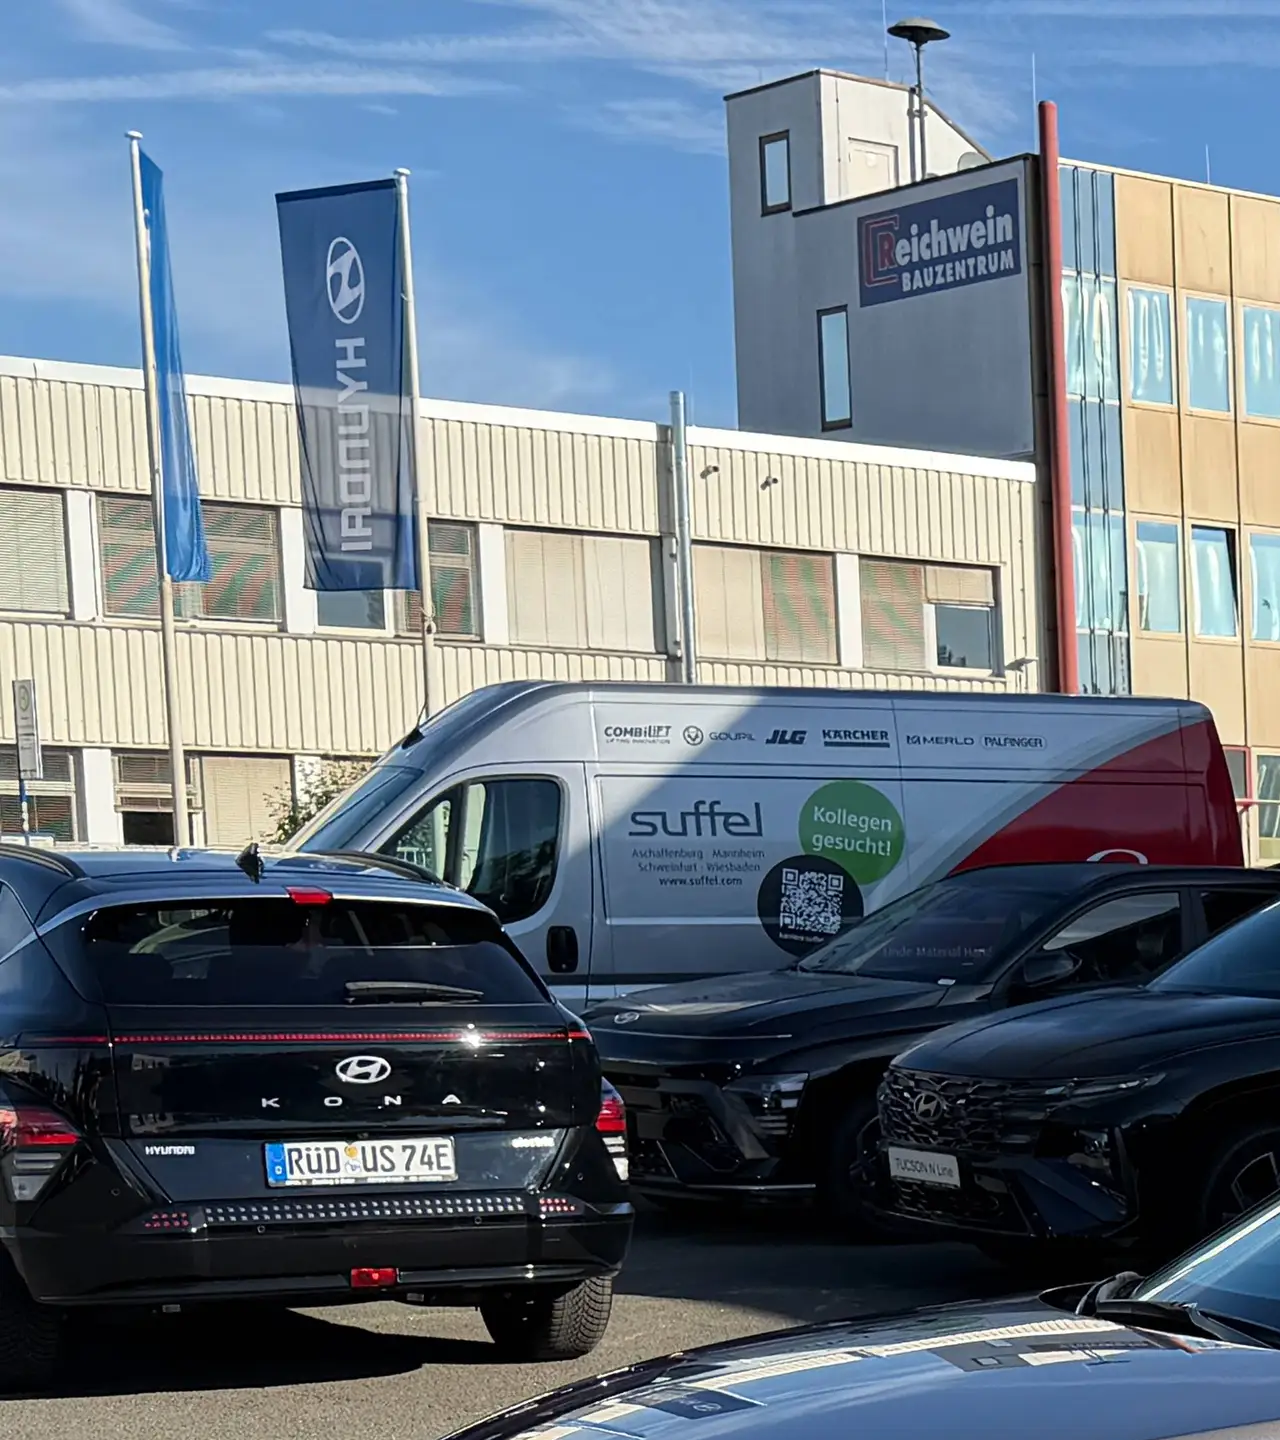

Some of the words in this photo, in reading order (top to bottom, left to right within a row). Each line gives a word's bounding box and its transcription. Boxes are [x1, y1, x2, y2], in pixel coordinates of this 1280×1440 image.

[876, 204, 1014, 271] Reichwein
[901, 248, 1015, 292] BAUZENTRUM
[765, 729, 807, 745] JLG
[822, 728, 889, 741] KÄRCHER
[923, 735, 975, 746] MERLO
[628, 800, 763, 837] suffel
[813, 805, 892, 833] Kollegen
[812, 833, 892, 857] gesucht!
[632, 847, 704, 860] Aschaffenburg
[712, 848, 765, 859] Mannheim
[638, 861, 698, 873] Schweinfurt
[706, 861, 760, 873] Wiesbaden
[659, 875, 743, 887] www.suffel.com
[261, 1094, 462, 1108] KONA
[145, 1145, 196, 1156] HYUNDAI
[287, 1146, 341, 1176] RÜD
[362, 1144, 396, 1173] US
[402, 1143, 452, 1172] 74E
